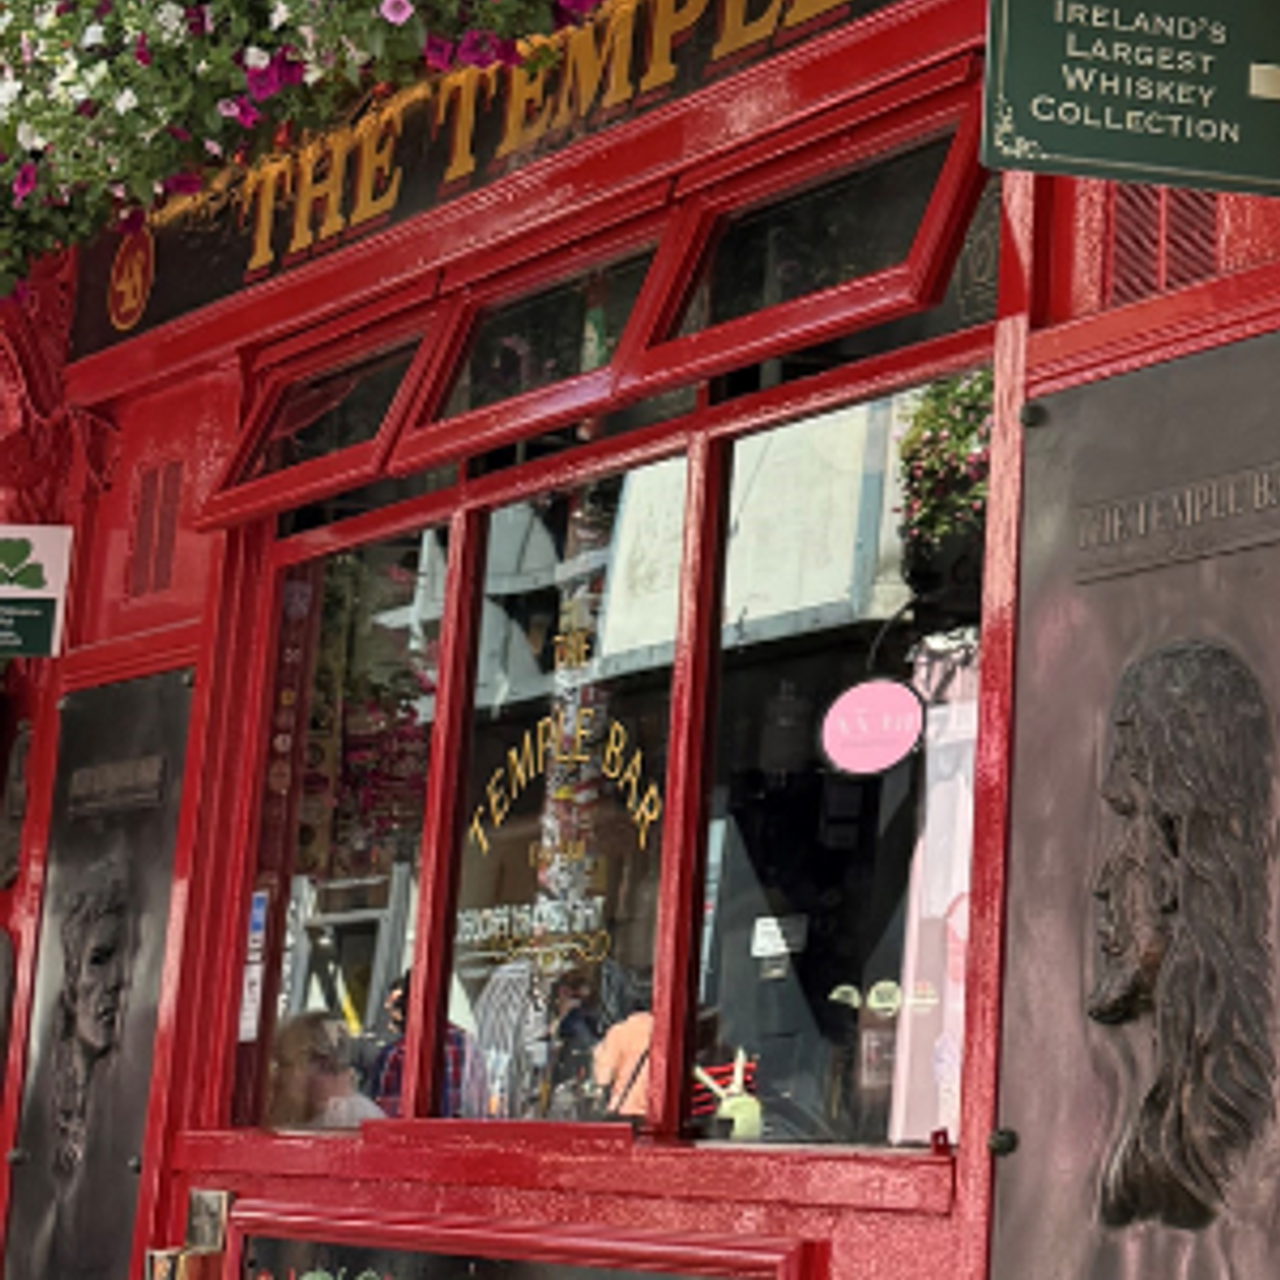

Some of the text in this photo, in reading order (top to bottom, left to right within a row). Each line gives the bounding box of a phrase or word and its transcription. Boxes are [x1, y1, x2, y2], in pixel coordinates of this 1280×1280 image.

[1066, 33, 1217, 75] LARGEST
[1061, 64, 1218, 110] WHISKEY
[1030, 94, 1241, 144] COLLECTION
[243, 110, 403, 274] THE
[468, 706, 663, 856] TEMPLE BAR
